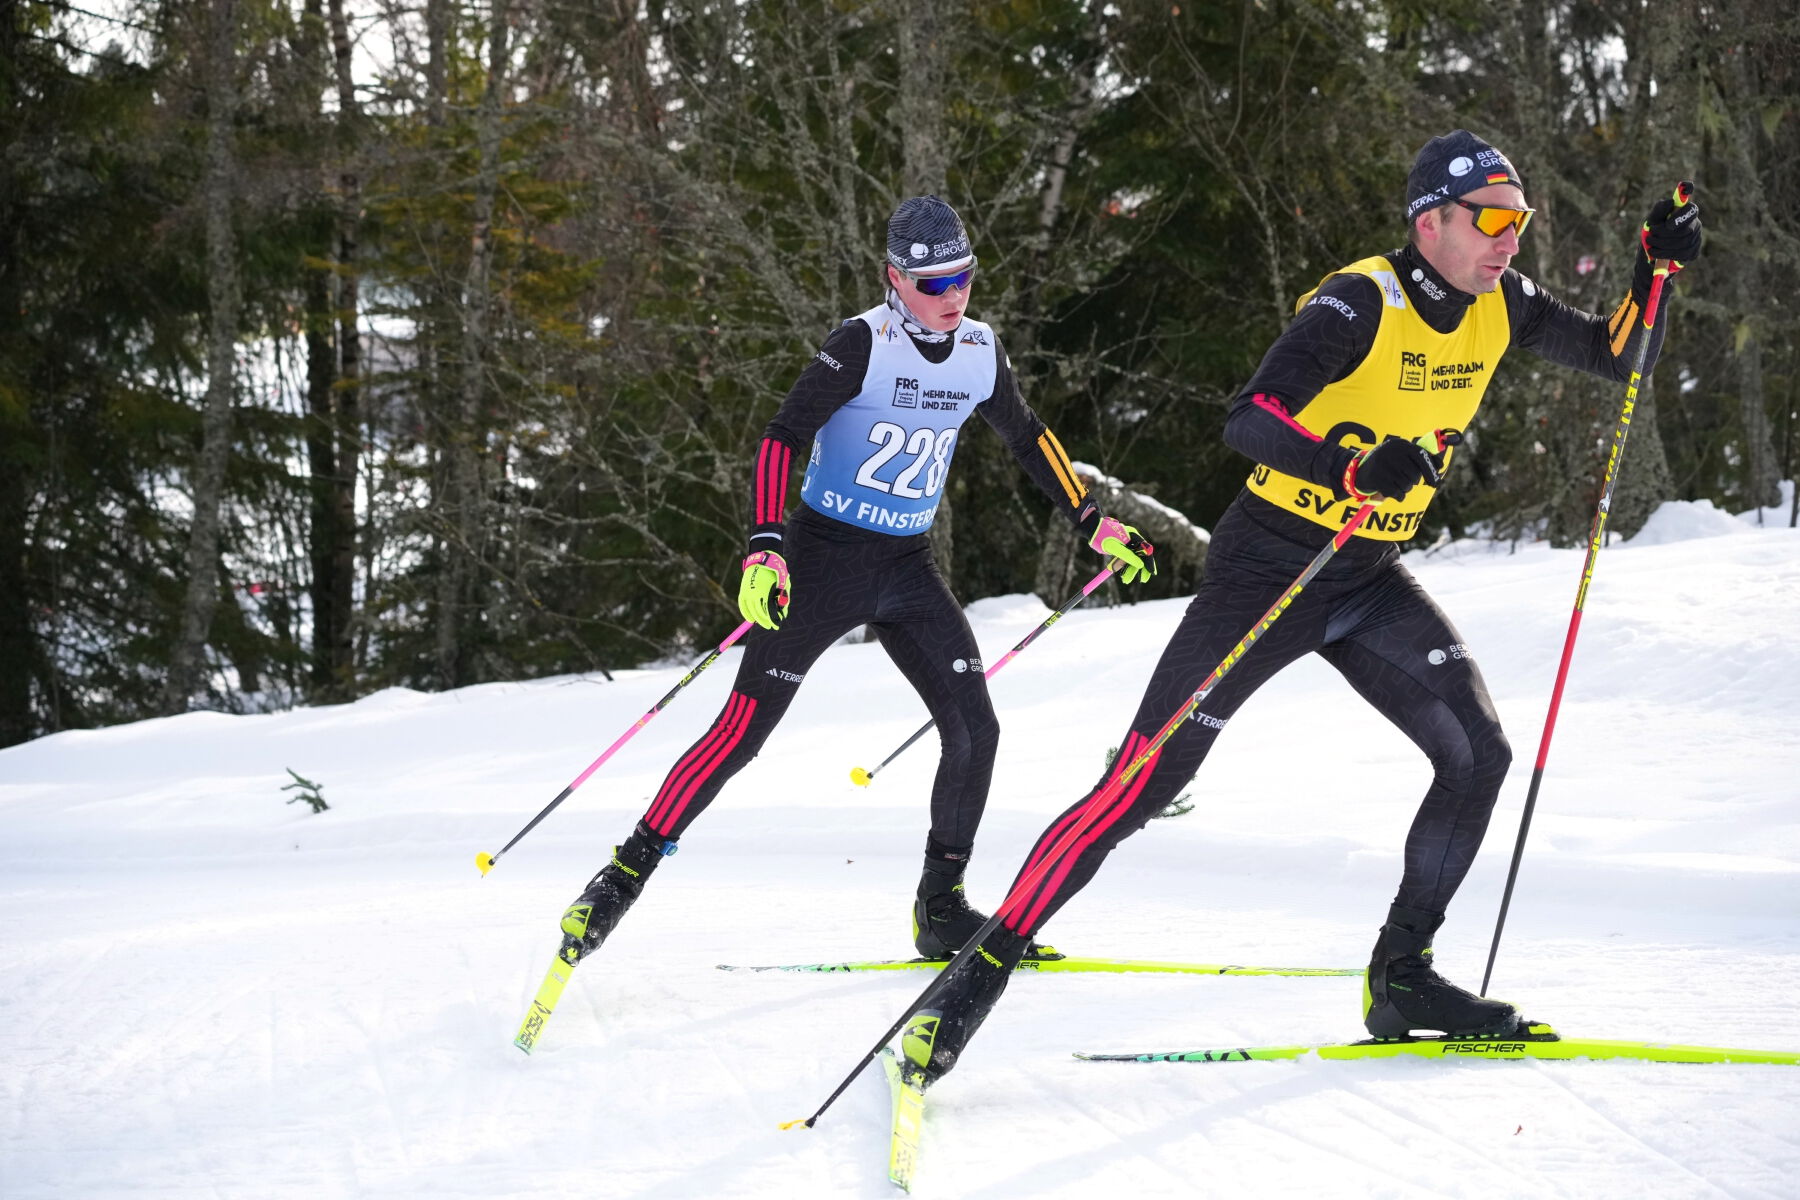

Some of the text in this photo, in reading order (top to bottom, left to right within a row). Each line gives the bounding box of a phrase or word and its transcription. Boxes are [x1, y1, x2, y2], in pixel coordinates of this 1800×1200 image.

[934, 241, 967, 258] GROUP
[1423, 278, 1447, 299] BERLAC
[1318, 295, 1358, 322] TERREX
[1401, 351, 1426, 367] FRG
[1431, 365, 1456, 376] MEHR
[895, 377, 919, 390] FRG
[1430, 379, 1450, 391] UND
[922, 389, 970, 401] MEHR RAUM
[1620, 371, 1642, 425] LEKI
[921, 400, 959, 411] UND ZEIT.
[854, 421, 957, 500] 228
[821, 490, 853, 514] SV
[1294, 488, 1336, 516] SV
[1255, 584, 1303, 631] LEKI
[1215, 630, 1256, 678] LEKI
[780, 670, 805, 683] TERRE
[1197, 711, 1227, 730] TERRE
[1442, 1043, 1526, 1053] FISCHER
